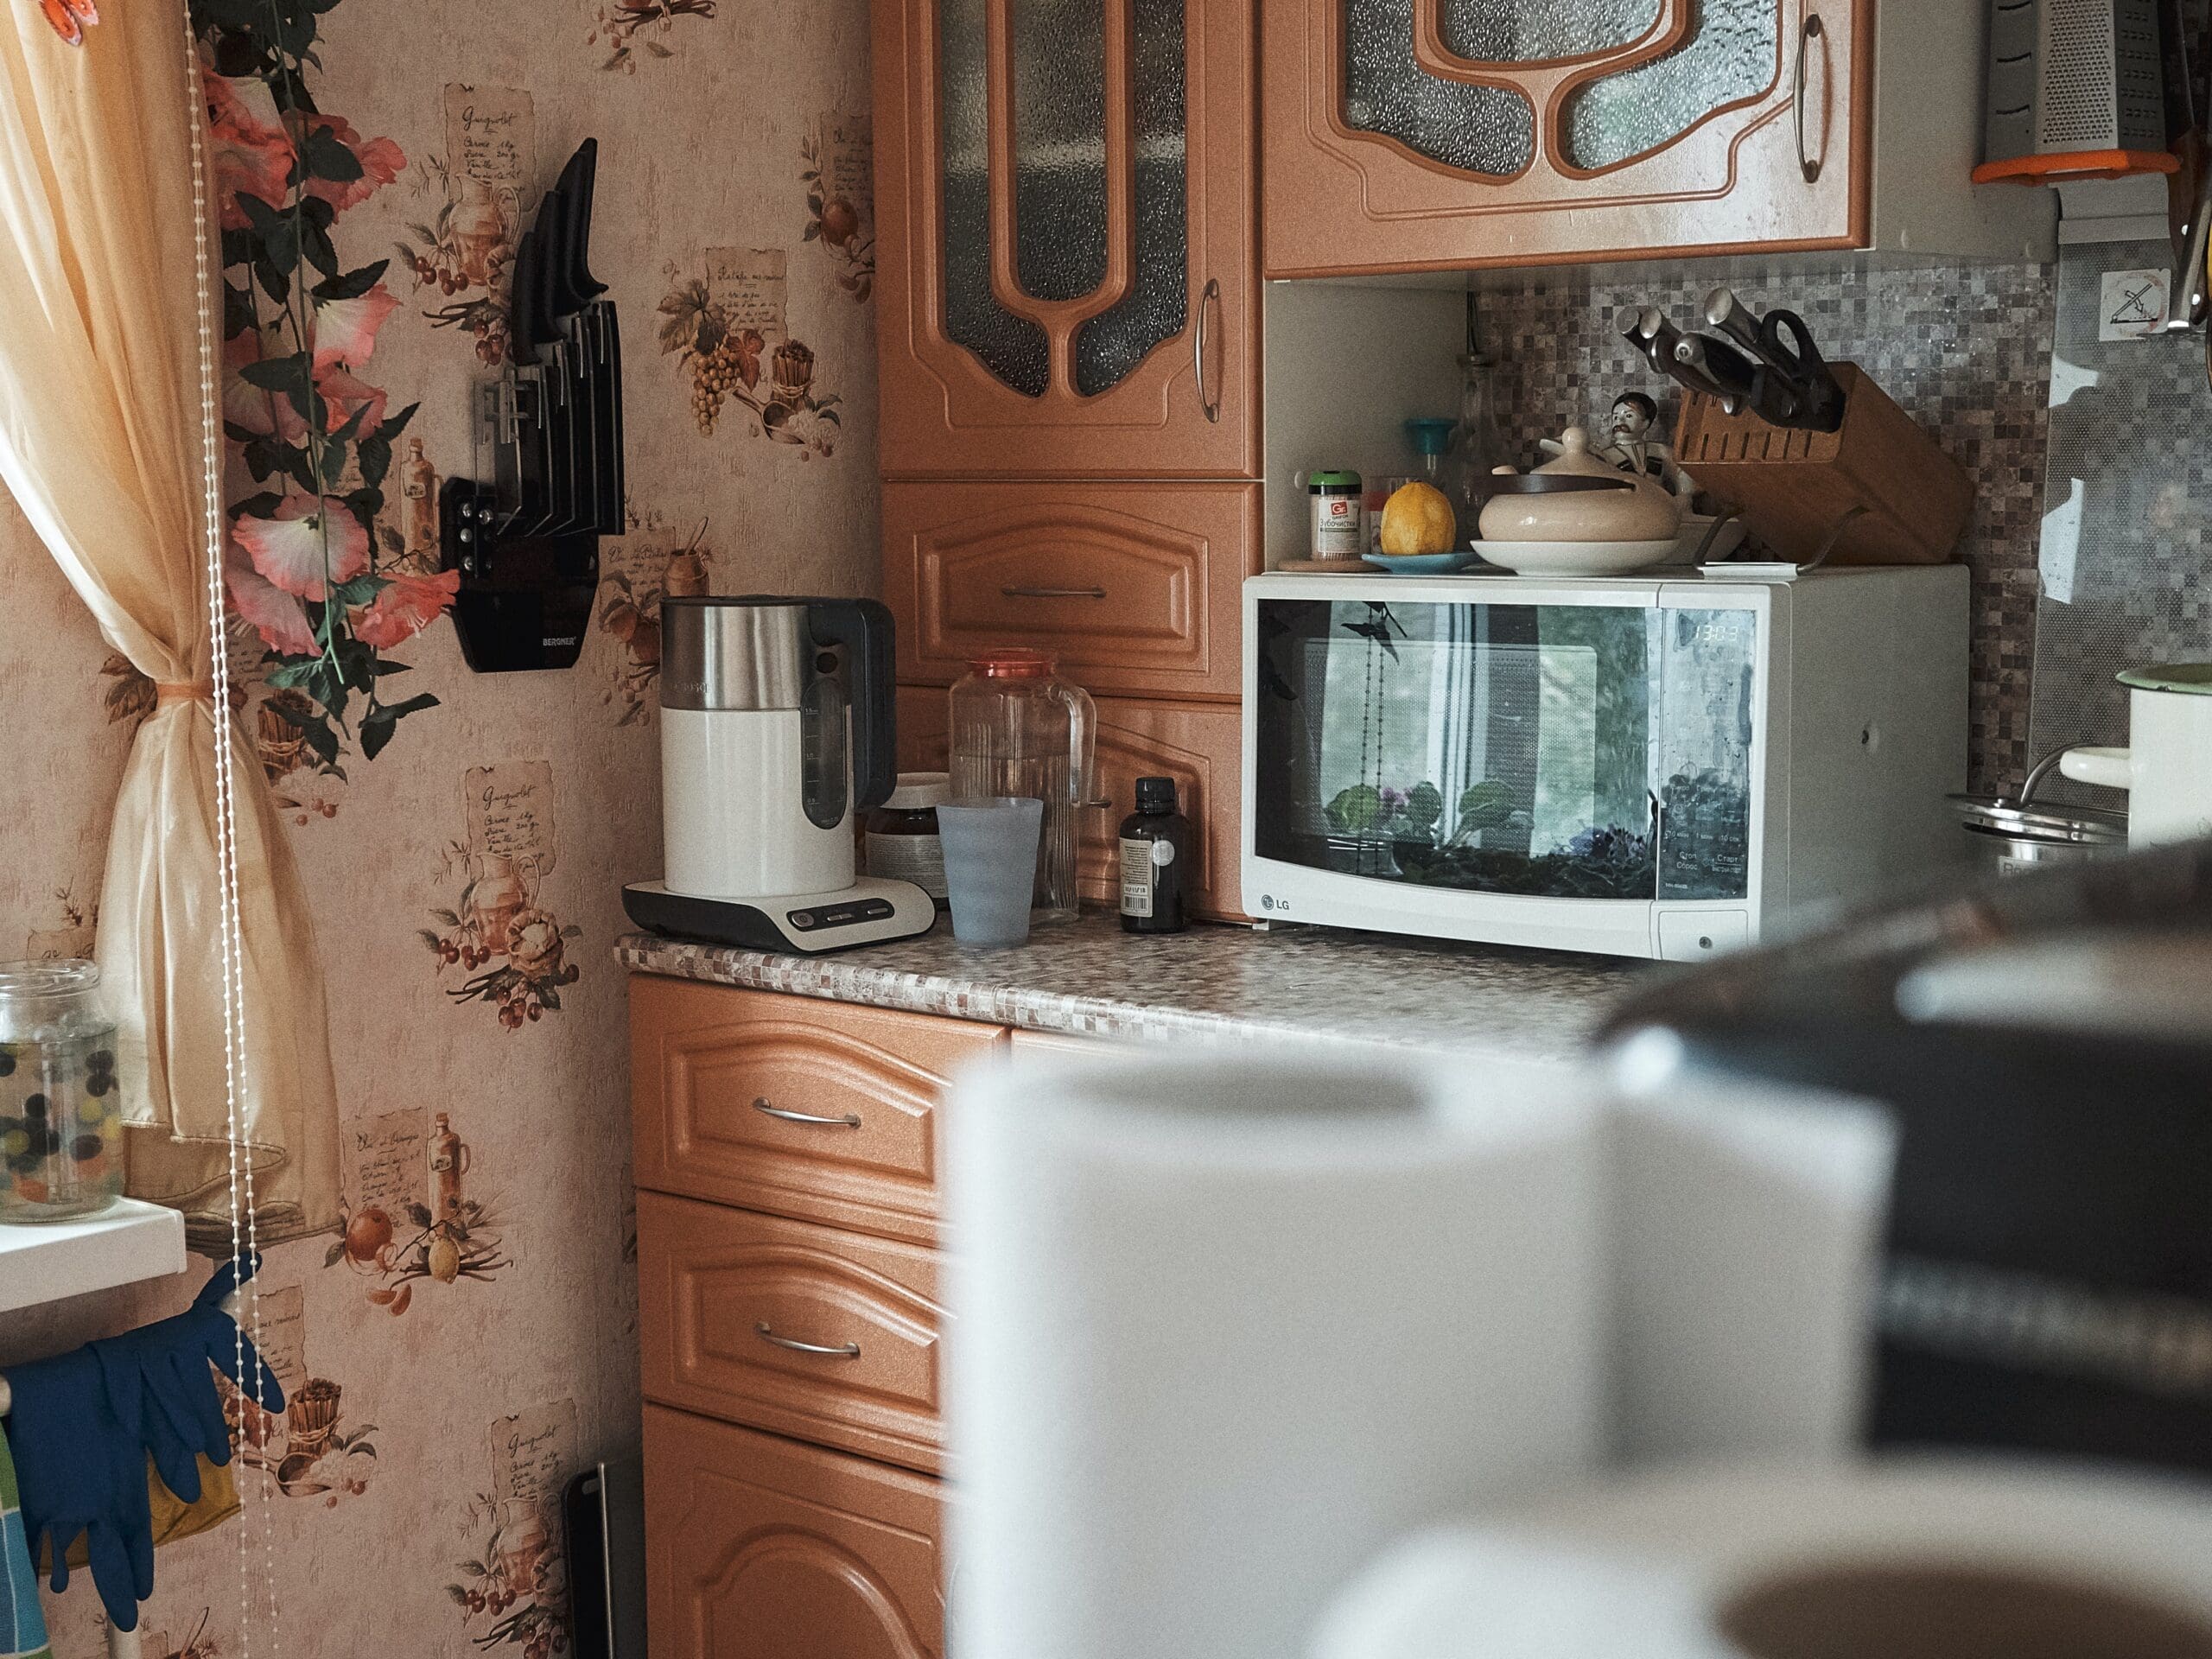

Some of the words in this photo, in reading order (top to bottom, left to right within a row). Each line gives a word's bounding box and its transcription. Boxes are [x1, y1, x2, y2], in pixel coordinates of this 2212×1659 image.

[1319, 518, 1355, 527] Зубочистки
[1695, 625, 1738, 642] 13:03
[543, 637, 575, 646] BERGNER
[1680, 851, 1697, 860] Стоп
[1717, 854, 1738, 863] Старт
[1676, 861, 1698, 871] Сброс
[1276, 899, 1289, 910] LG
